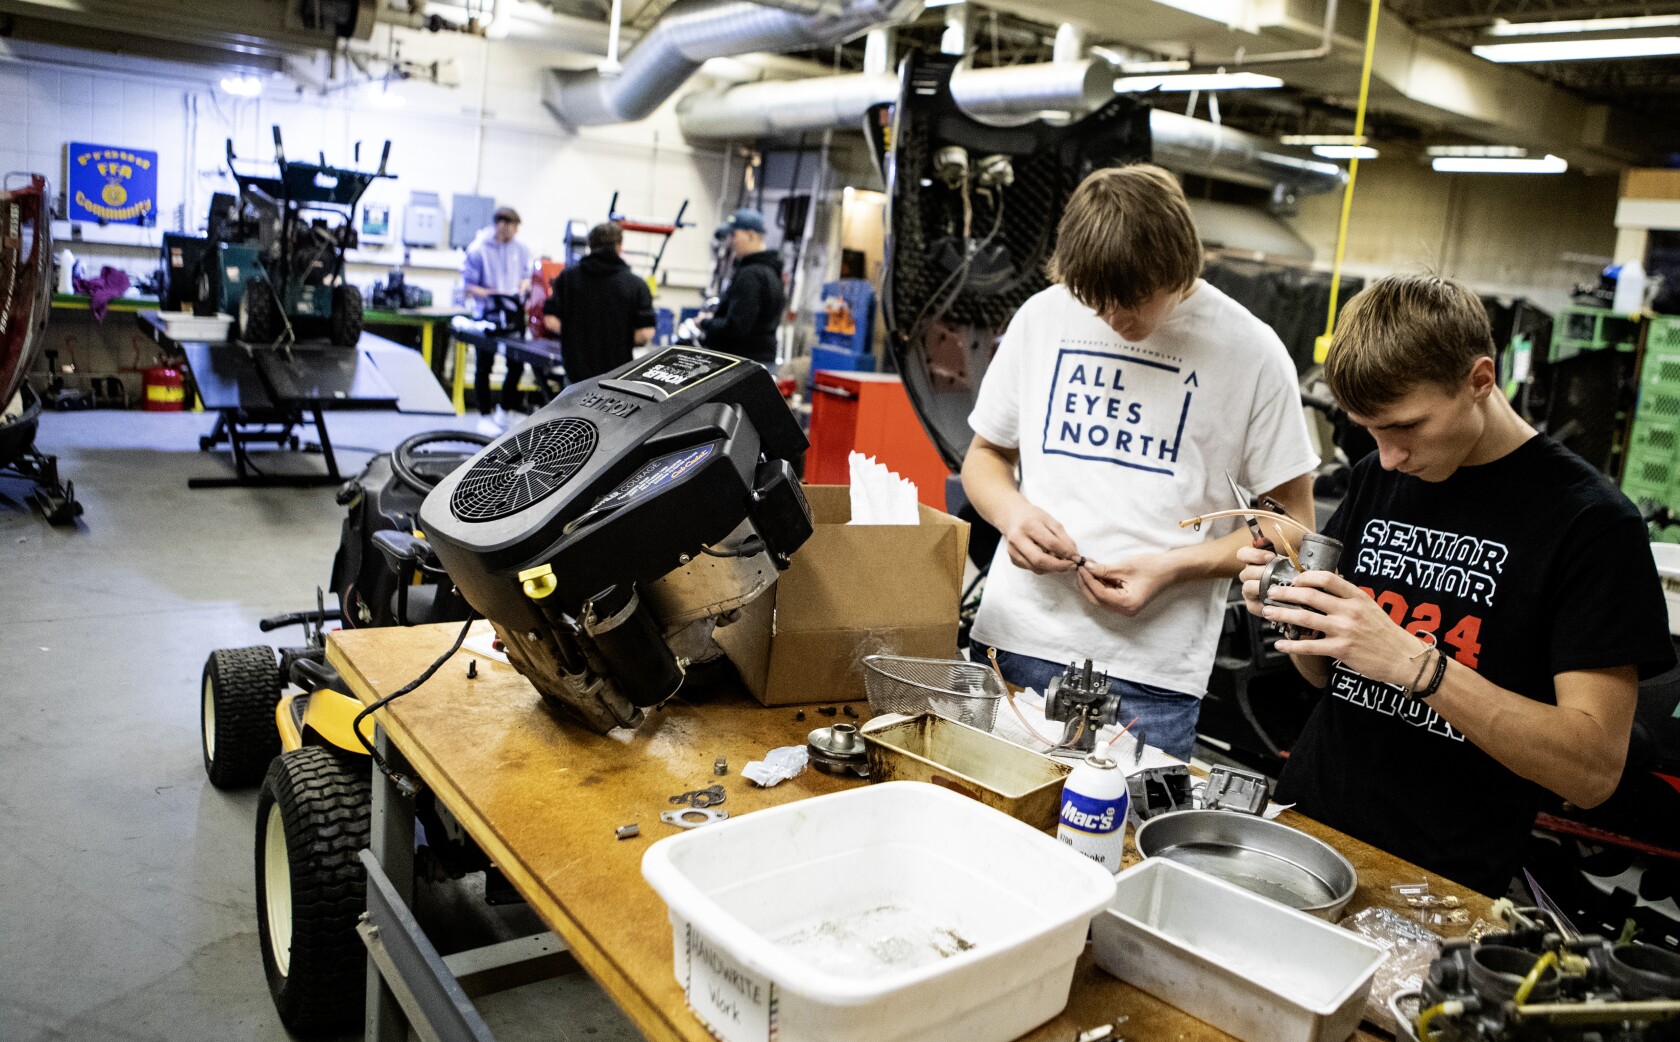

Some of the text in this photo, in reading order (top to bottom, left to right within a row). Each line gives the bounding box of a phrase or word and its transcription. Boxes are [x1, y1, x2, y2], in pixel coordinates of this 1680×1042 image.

[97, 162, 132, 179] FFA
[75, 190, 151, 220] Community
[1068, 364, 1125, 391] ALL
[579, 392, 641, 419] KOHLER
[1065, 392, 1142, 424] EYES
[1060, 421, 1178, 462] NORTH
[620, 462, 659, 492] COURAGE
[670, 449, 710, 479] Cub Cadet
[1361, 519, 1509, 574] SENIOR
[1355, 548, 1497, 607] SENIOR
[1357, 585, 1482, 669] 024
[1061, 800, 1114, 830] Mac's
